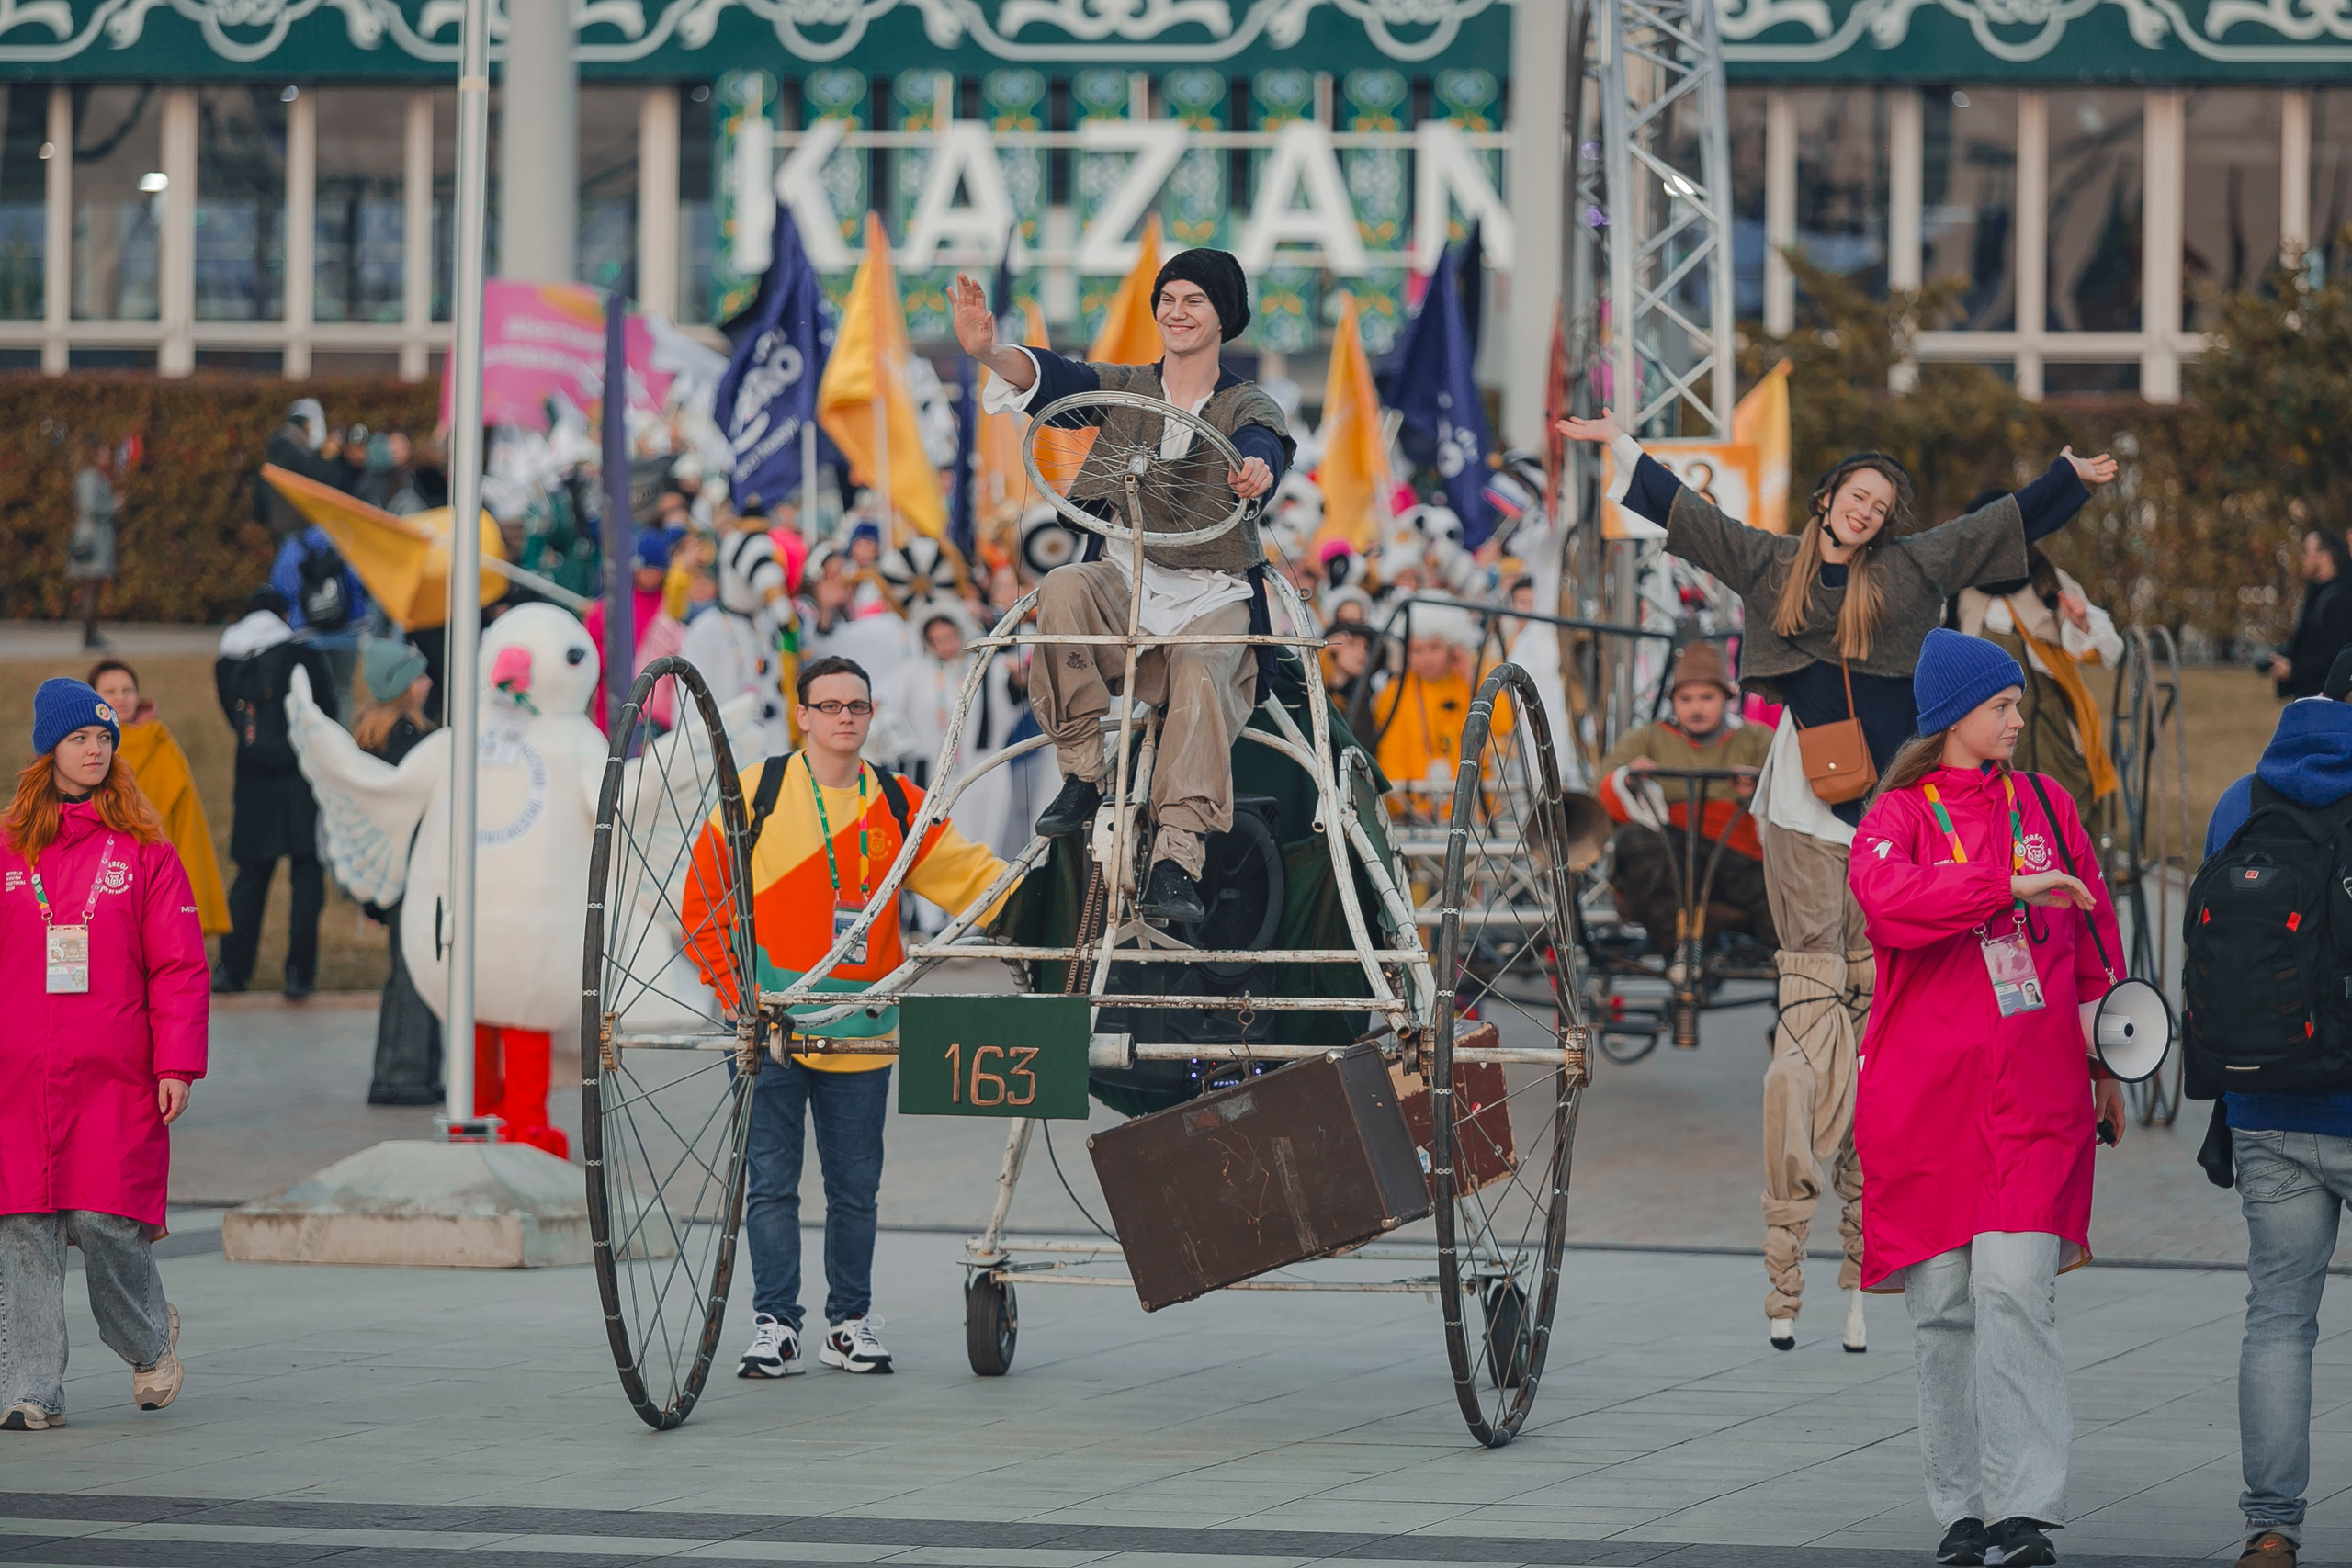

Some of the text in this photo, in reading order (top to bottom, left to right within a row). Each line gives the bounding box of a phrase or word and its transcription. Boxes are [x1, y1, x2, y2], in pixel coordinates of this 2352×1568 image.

[732, 118, 1515, 276] KAZAN
[107, 860, 129, 872] EREGI
[944, 1043, 1041, 1108] 163
